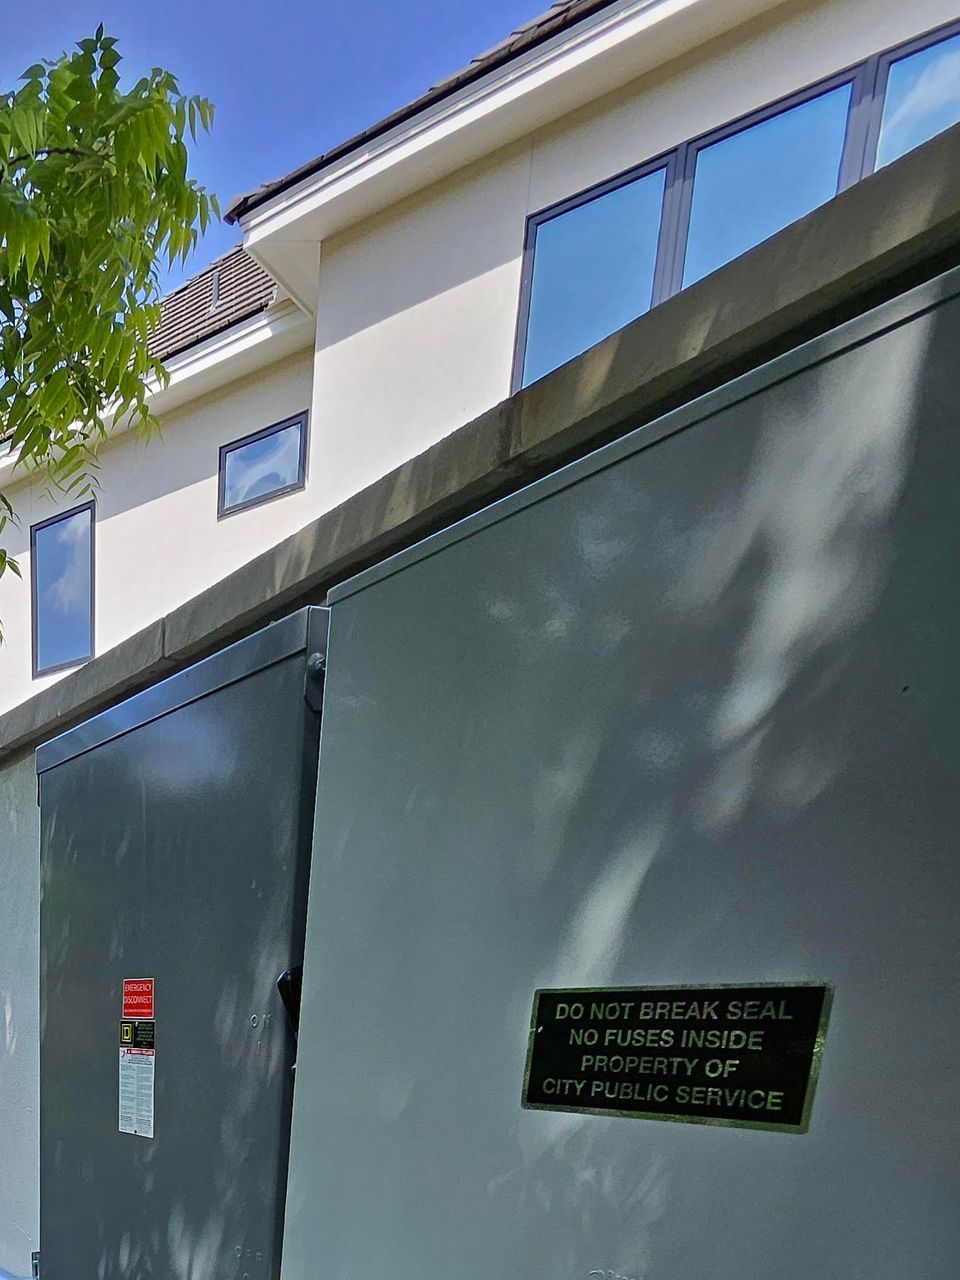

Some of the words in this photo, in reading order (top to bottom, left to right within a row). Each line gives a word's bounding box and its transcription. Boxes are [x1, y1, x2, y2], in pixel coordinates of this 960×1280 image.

[125, 984, 151, 992] EMERGENCY
[123, 995, 152, 1004] DISCONNECT
[555, 1003, 584, 1019] DO
[590, 1002, 634, 1019] NOT
[639, 1001, 718, 1020] BREAK
[726, 1000, 793, 1020] SEAL
[569, 1029, 599, 1046] NO
[604, 1029, 674, 1047] FUSES
[681, 1030, 764, 1050] INSIDE
[581, 1055, 700, 1075] PROPERTY
[705, 1059, 739, 1078] OF
[542, 1078, 586, 1096] CITY
[591, 1084, 669, 1102] PUBLIC
[675, 1087, 784, 1110] SERVICE
